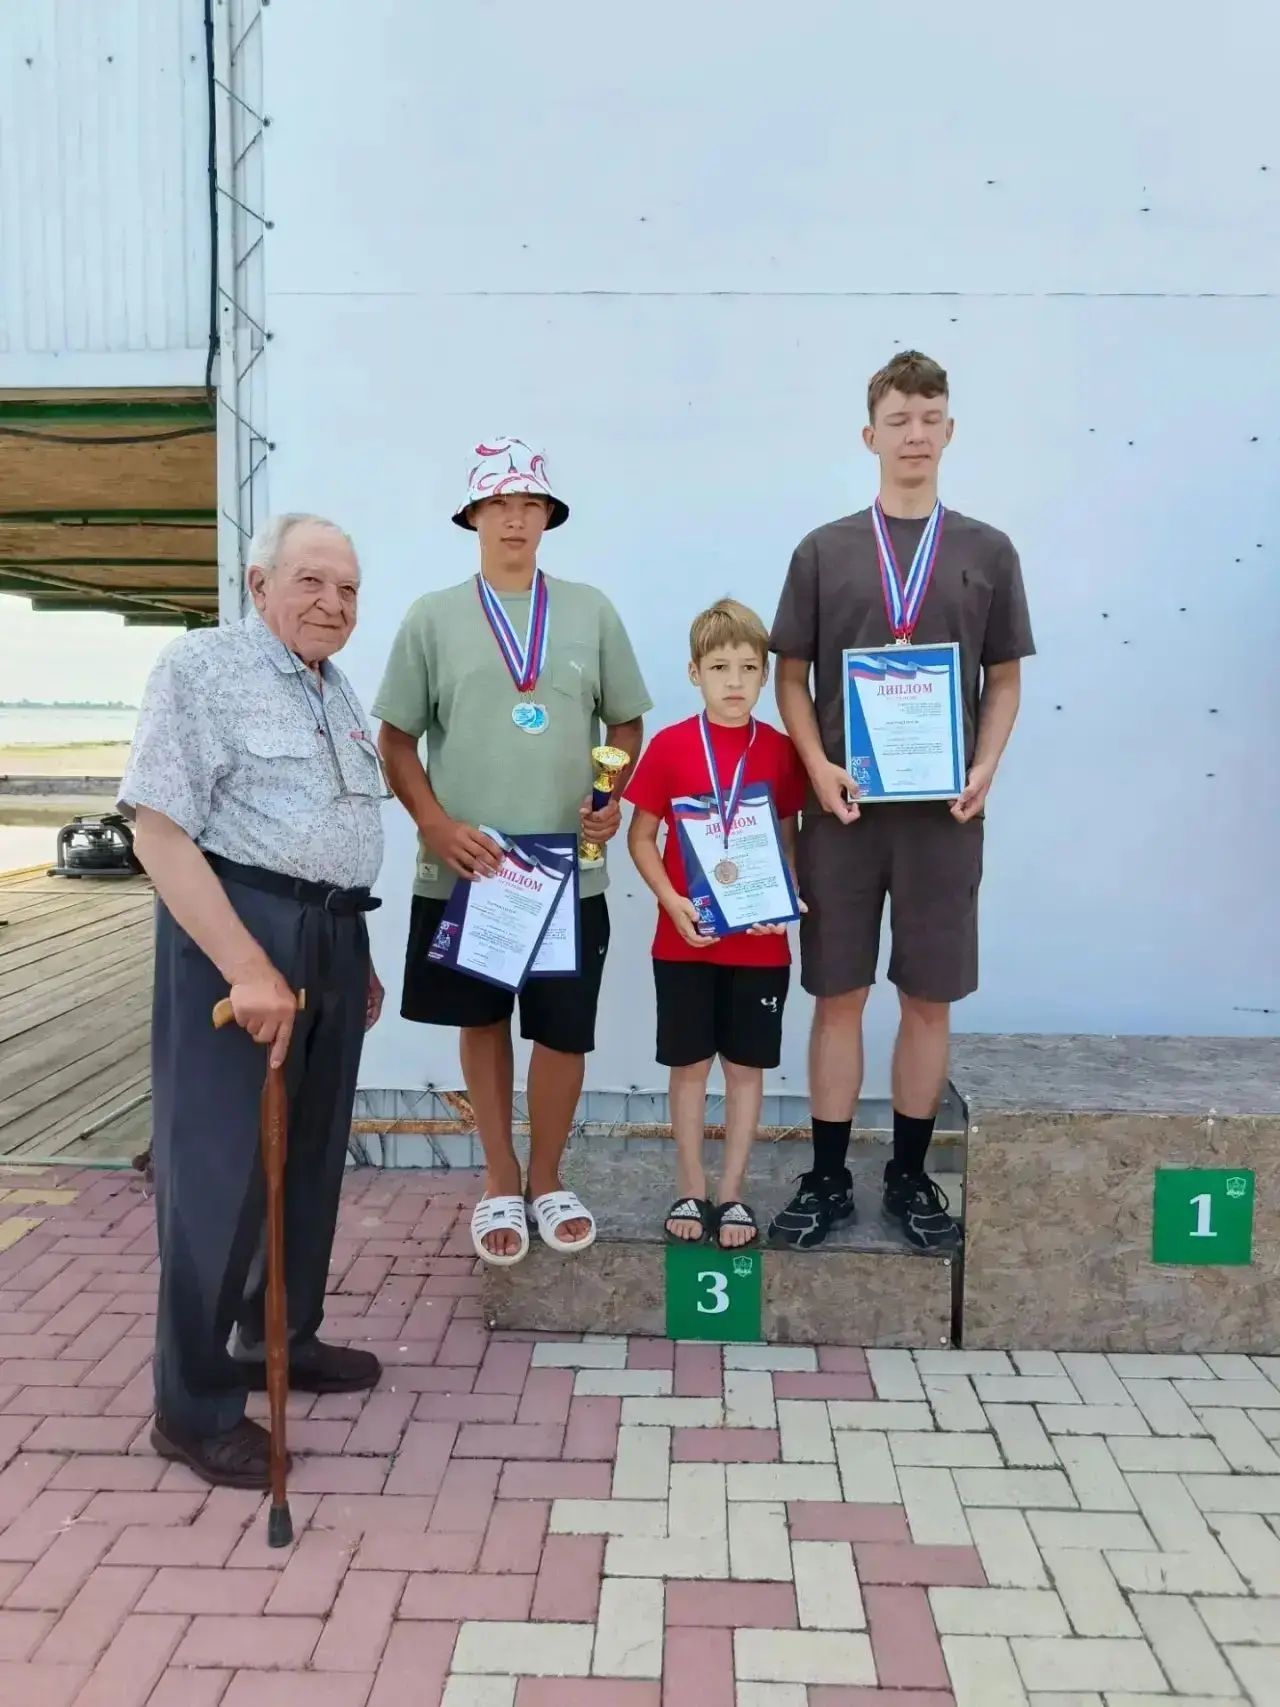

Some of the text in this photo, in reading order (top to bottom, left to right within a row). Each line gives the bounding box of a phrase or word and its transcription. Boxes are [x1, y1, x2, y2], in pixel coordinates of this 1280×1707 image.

[877, 682, 933, 697] ДИПЛОМ
[705, 815, 758, 836] ДИЛОМ
[494, 867, 543, 892] ИПЛОМ
[1189, 1193, 1218, 1237] 1
[697, 1271, 729, 1314] 3
